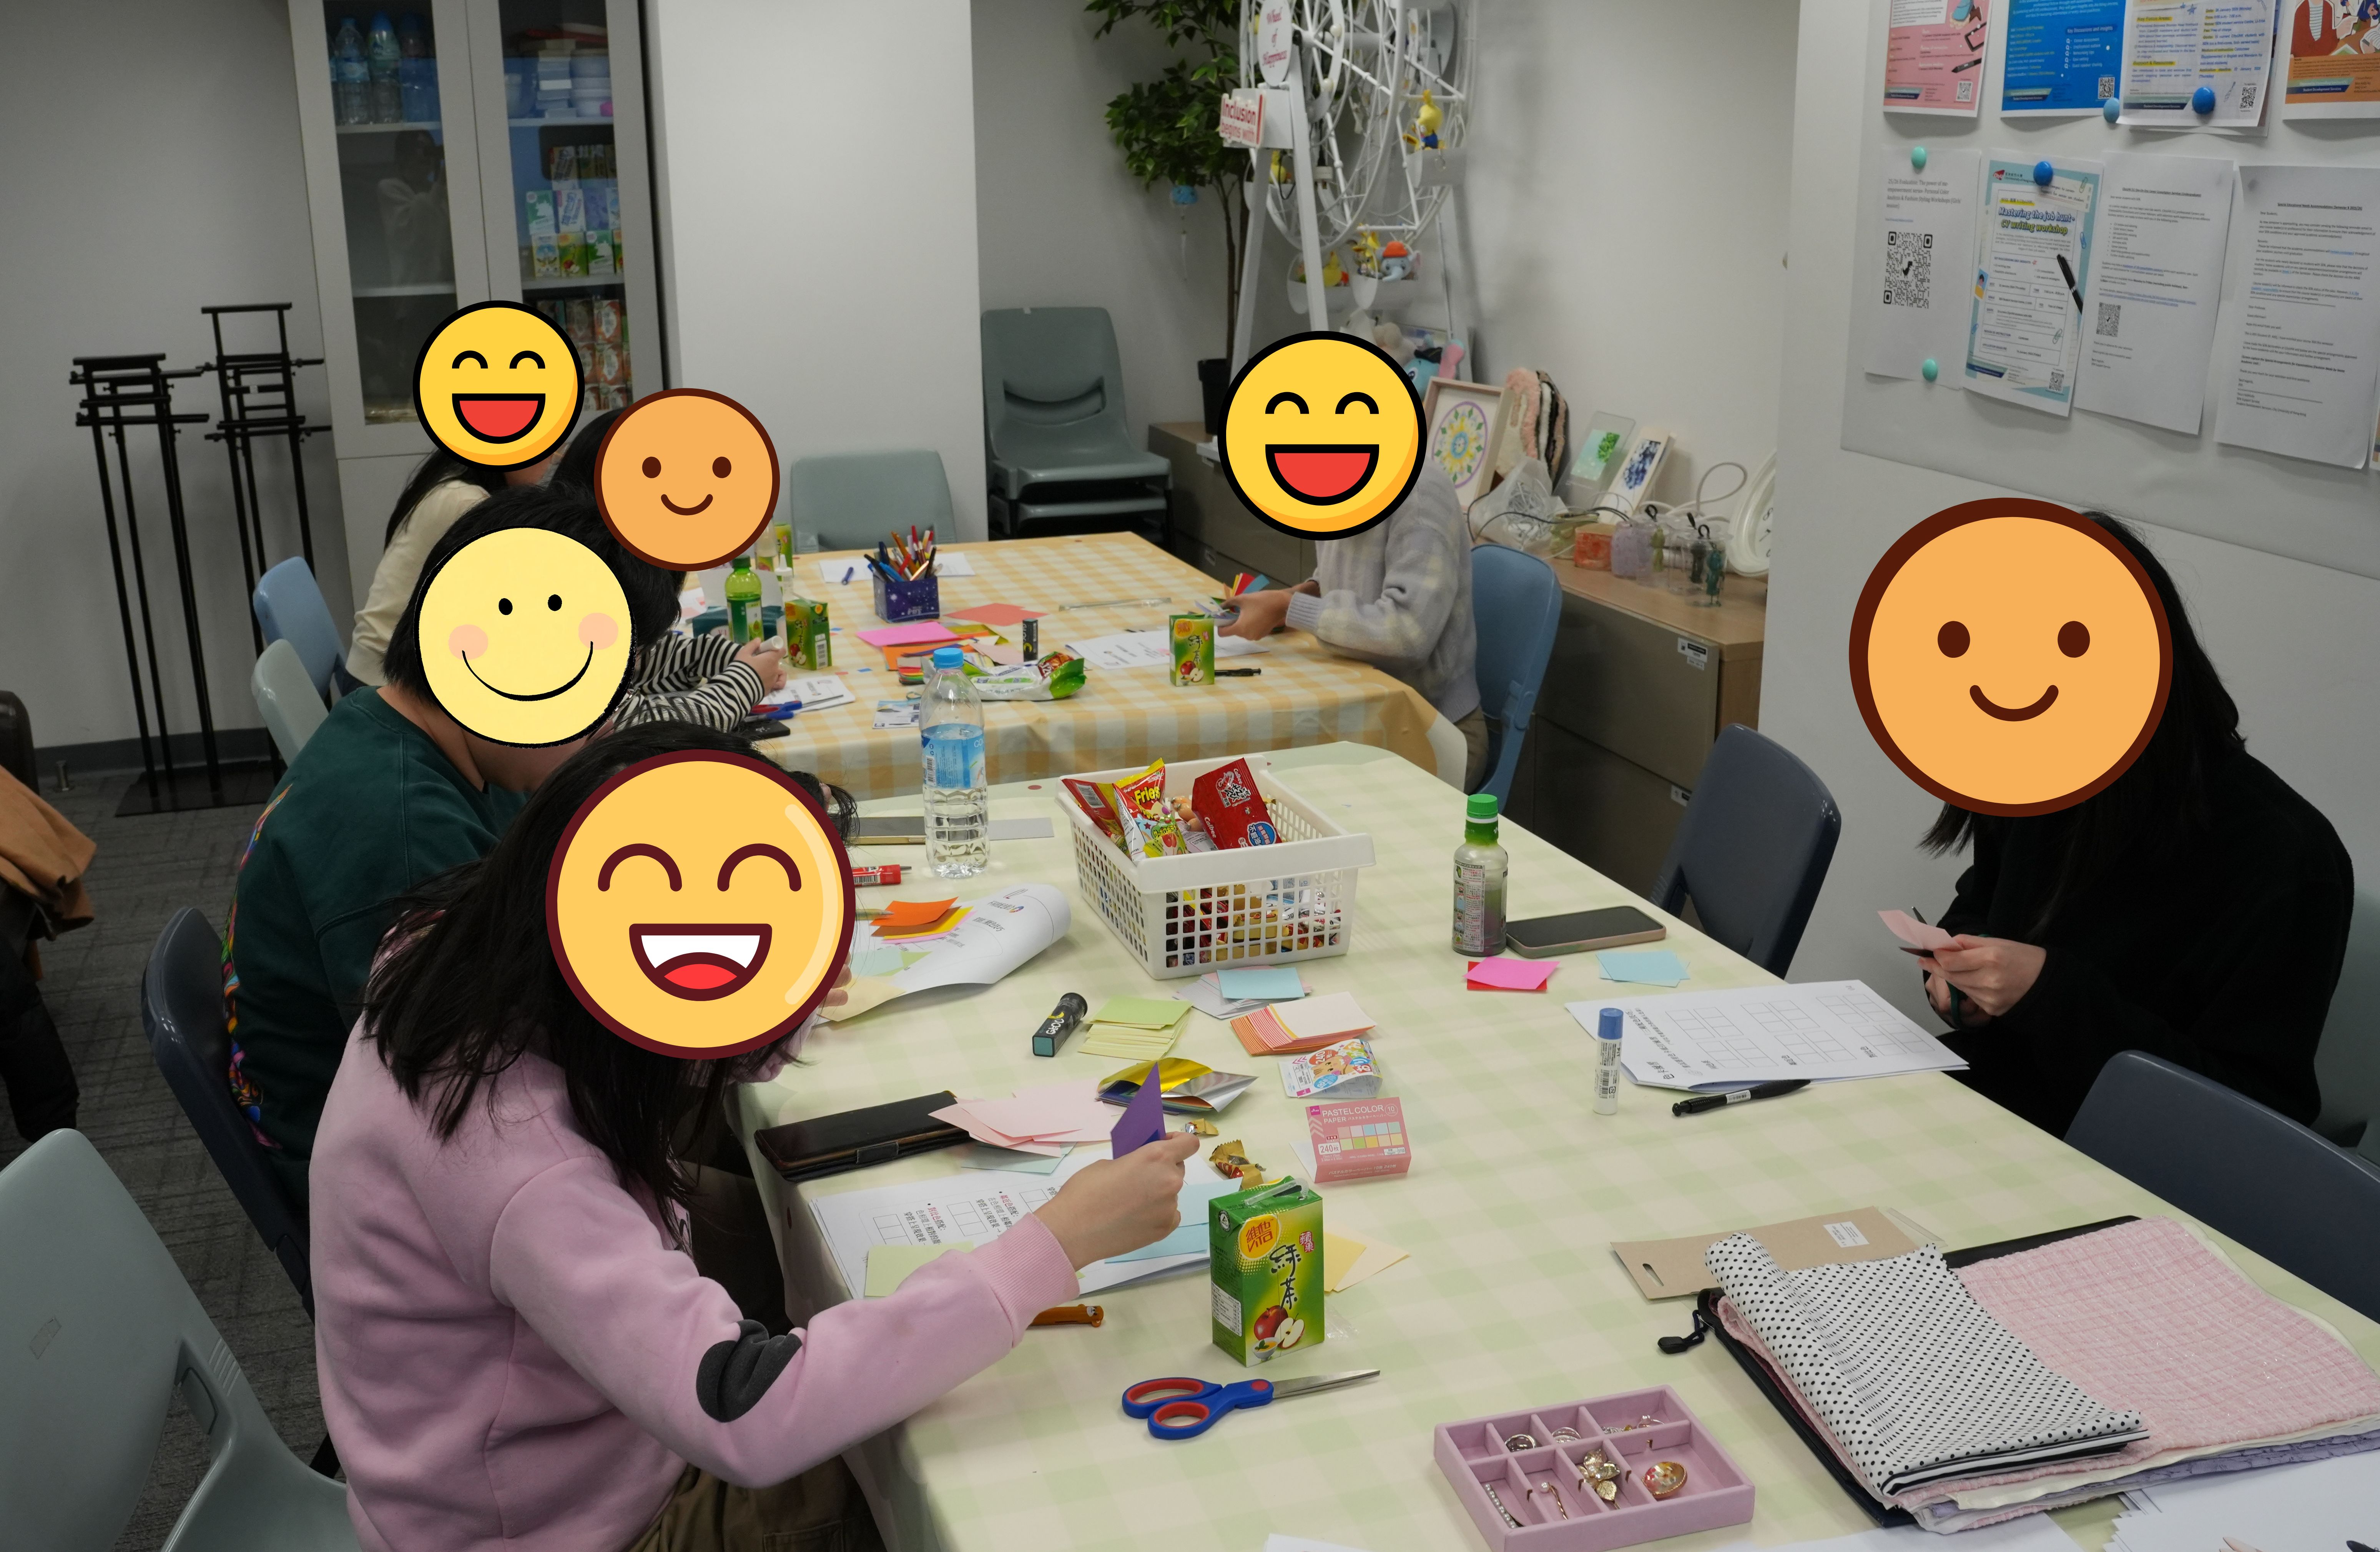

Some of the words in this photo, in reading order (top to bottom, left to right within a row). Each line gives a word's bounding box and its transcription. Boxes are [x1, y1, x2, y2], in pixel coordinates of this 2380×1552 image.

[1222, 98, 1256, 126] Inclusion
[1221, 121, 1241, 140] begins
[1242, 127, 1256, 143] with
[1998, 207, 2031, 220] Mastering
[2032, 210, 2043, 219] the
[2043, 210, 2055, 221] job
[2056, 211, 2071, 222] hunt
[2001, 219, 2010, 228] CV
[2011, 221, 2035, 233] writing
[2036, 223, 2068, 236] workshop
[1233, 769, 1243, 785] Calbee
[1134, 786, 1161, 805] Fries
[1204, 817, 1216, 838] Calbee
[1249, 824, 1263, 846] 不經油
[1316, 1050, 1326, 1065] 240
[1322, 1108, 1354, 1117] PASTEL
[1355, 1105, 1384, 1114] COLOR
[1246, 1219, 1271, 1243] 維他
[1299, 1231, 1315, 1253] 蘋果
[1269, 1244, 1302, 1310] 綠茶
